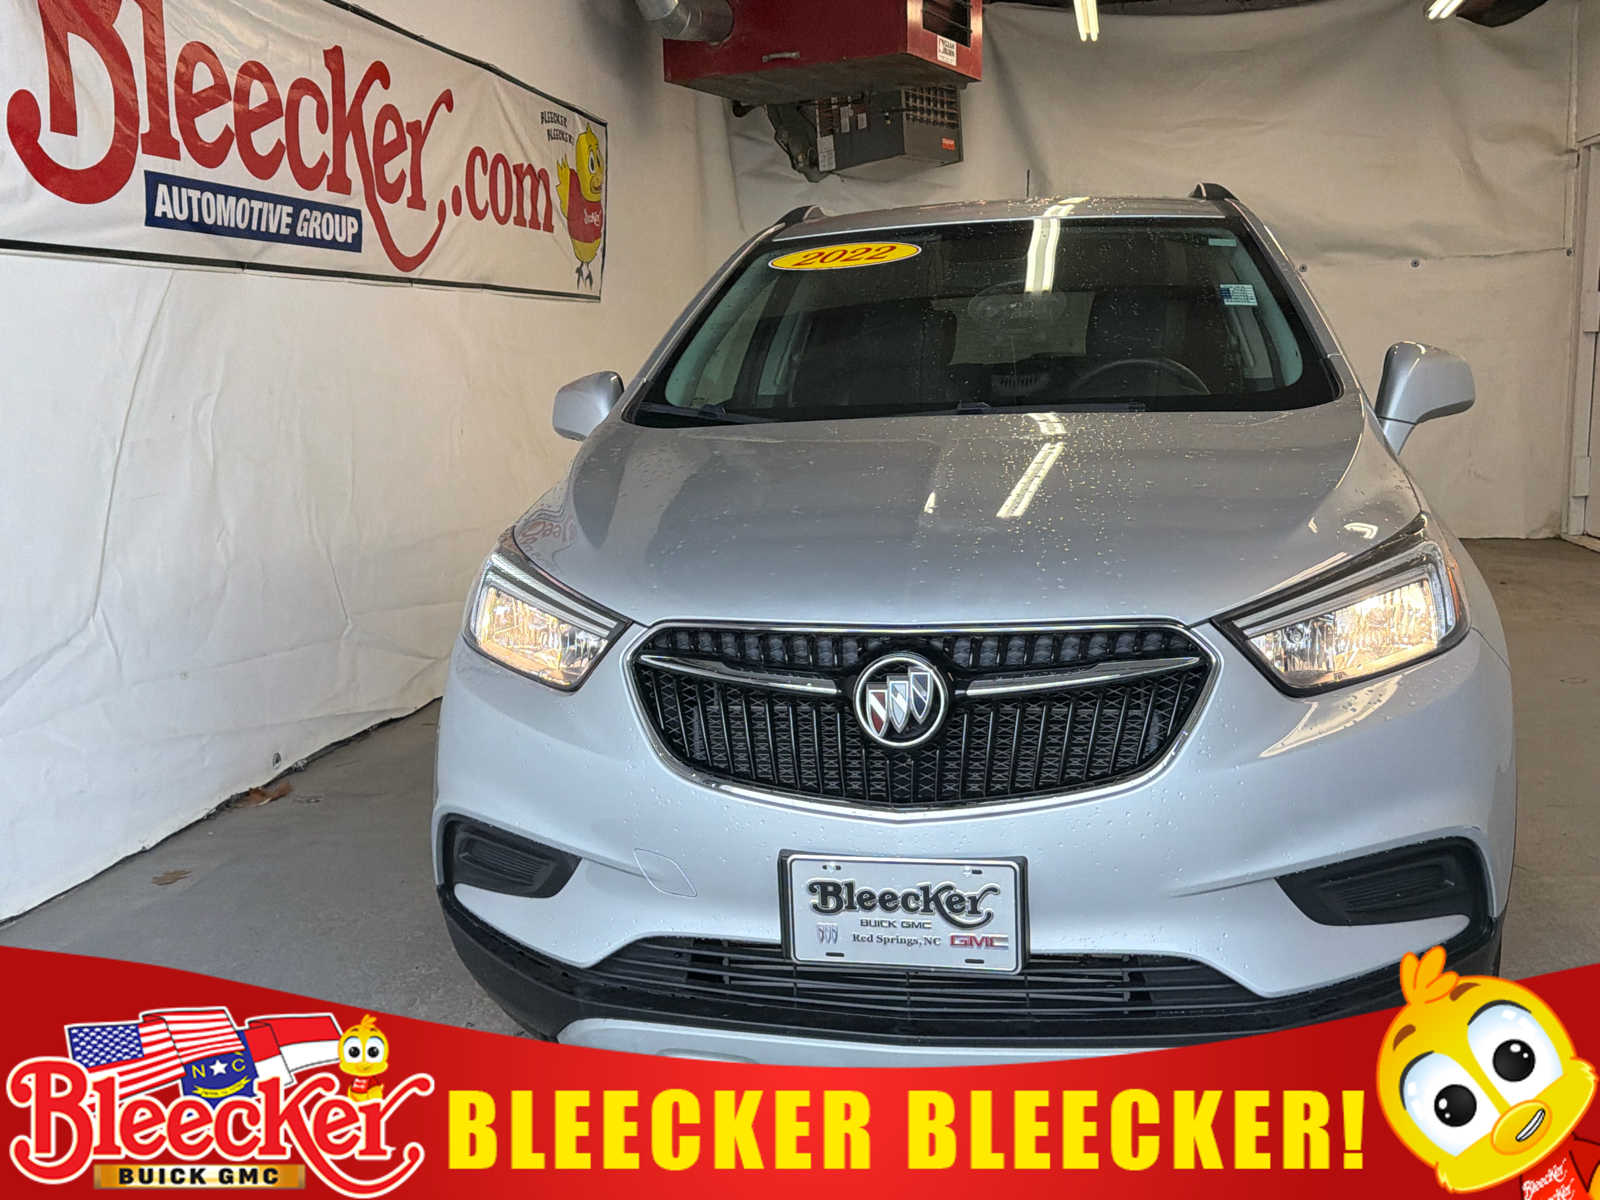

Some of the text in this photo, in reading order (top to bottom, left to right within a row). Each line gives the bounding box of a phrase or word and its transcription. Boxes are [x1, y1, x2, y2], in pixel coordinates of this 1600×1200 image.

[154, 183, 359, 243] AUTOMOTIVE GROUP
[792, 245, 897, 267] 2022
[807, 878, 1000, 930] Bleecker
[860, 919, 932, 930] BUICK GMC
[852, 933, 873, 943] Red
[950, 934, 1009, 950] GMC
